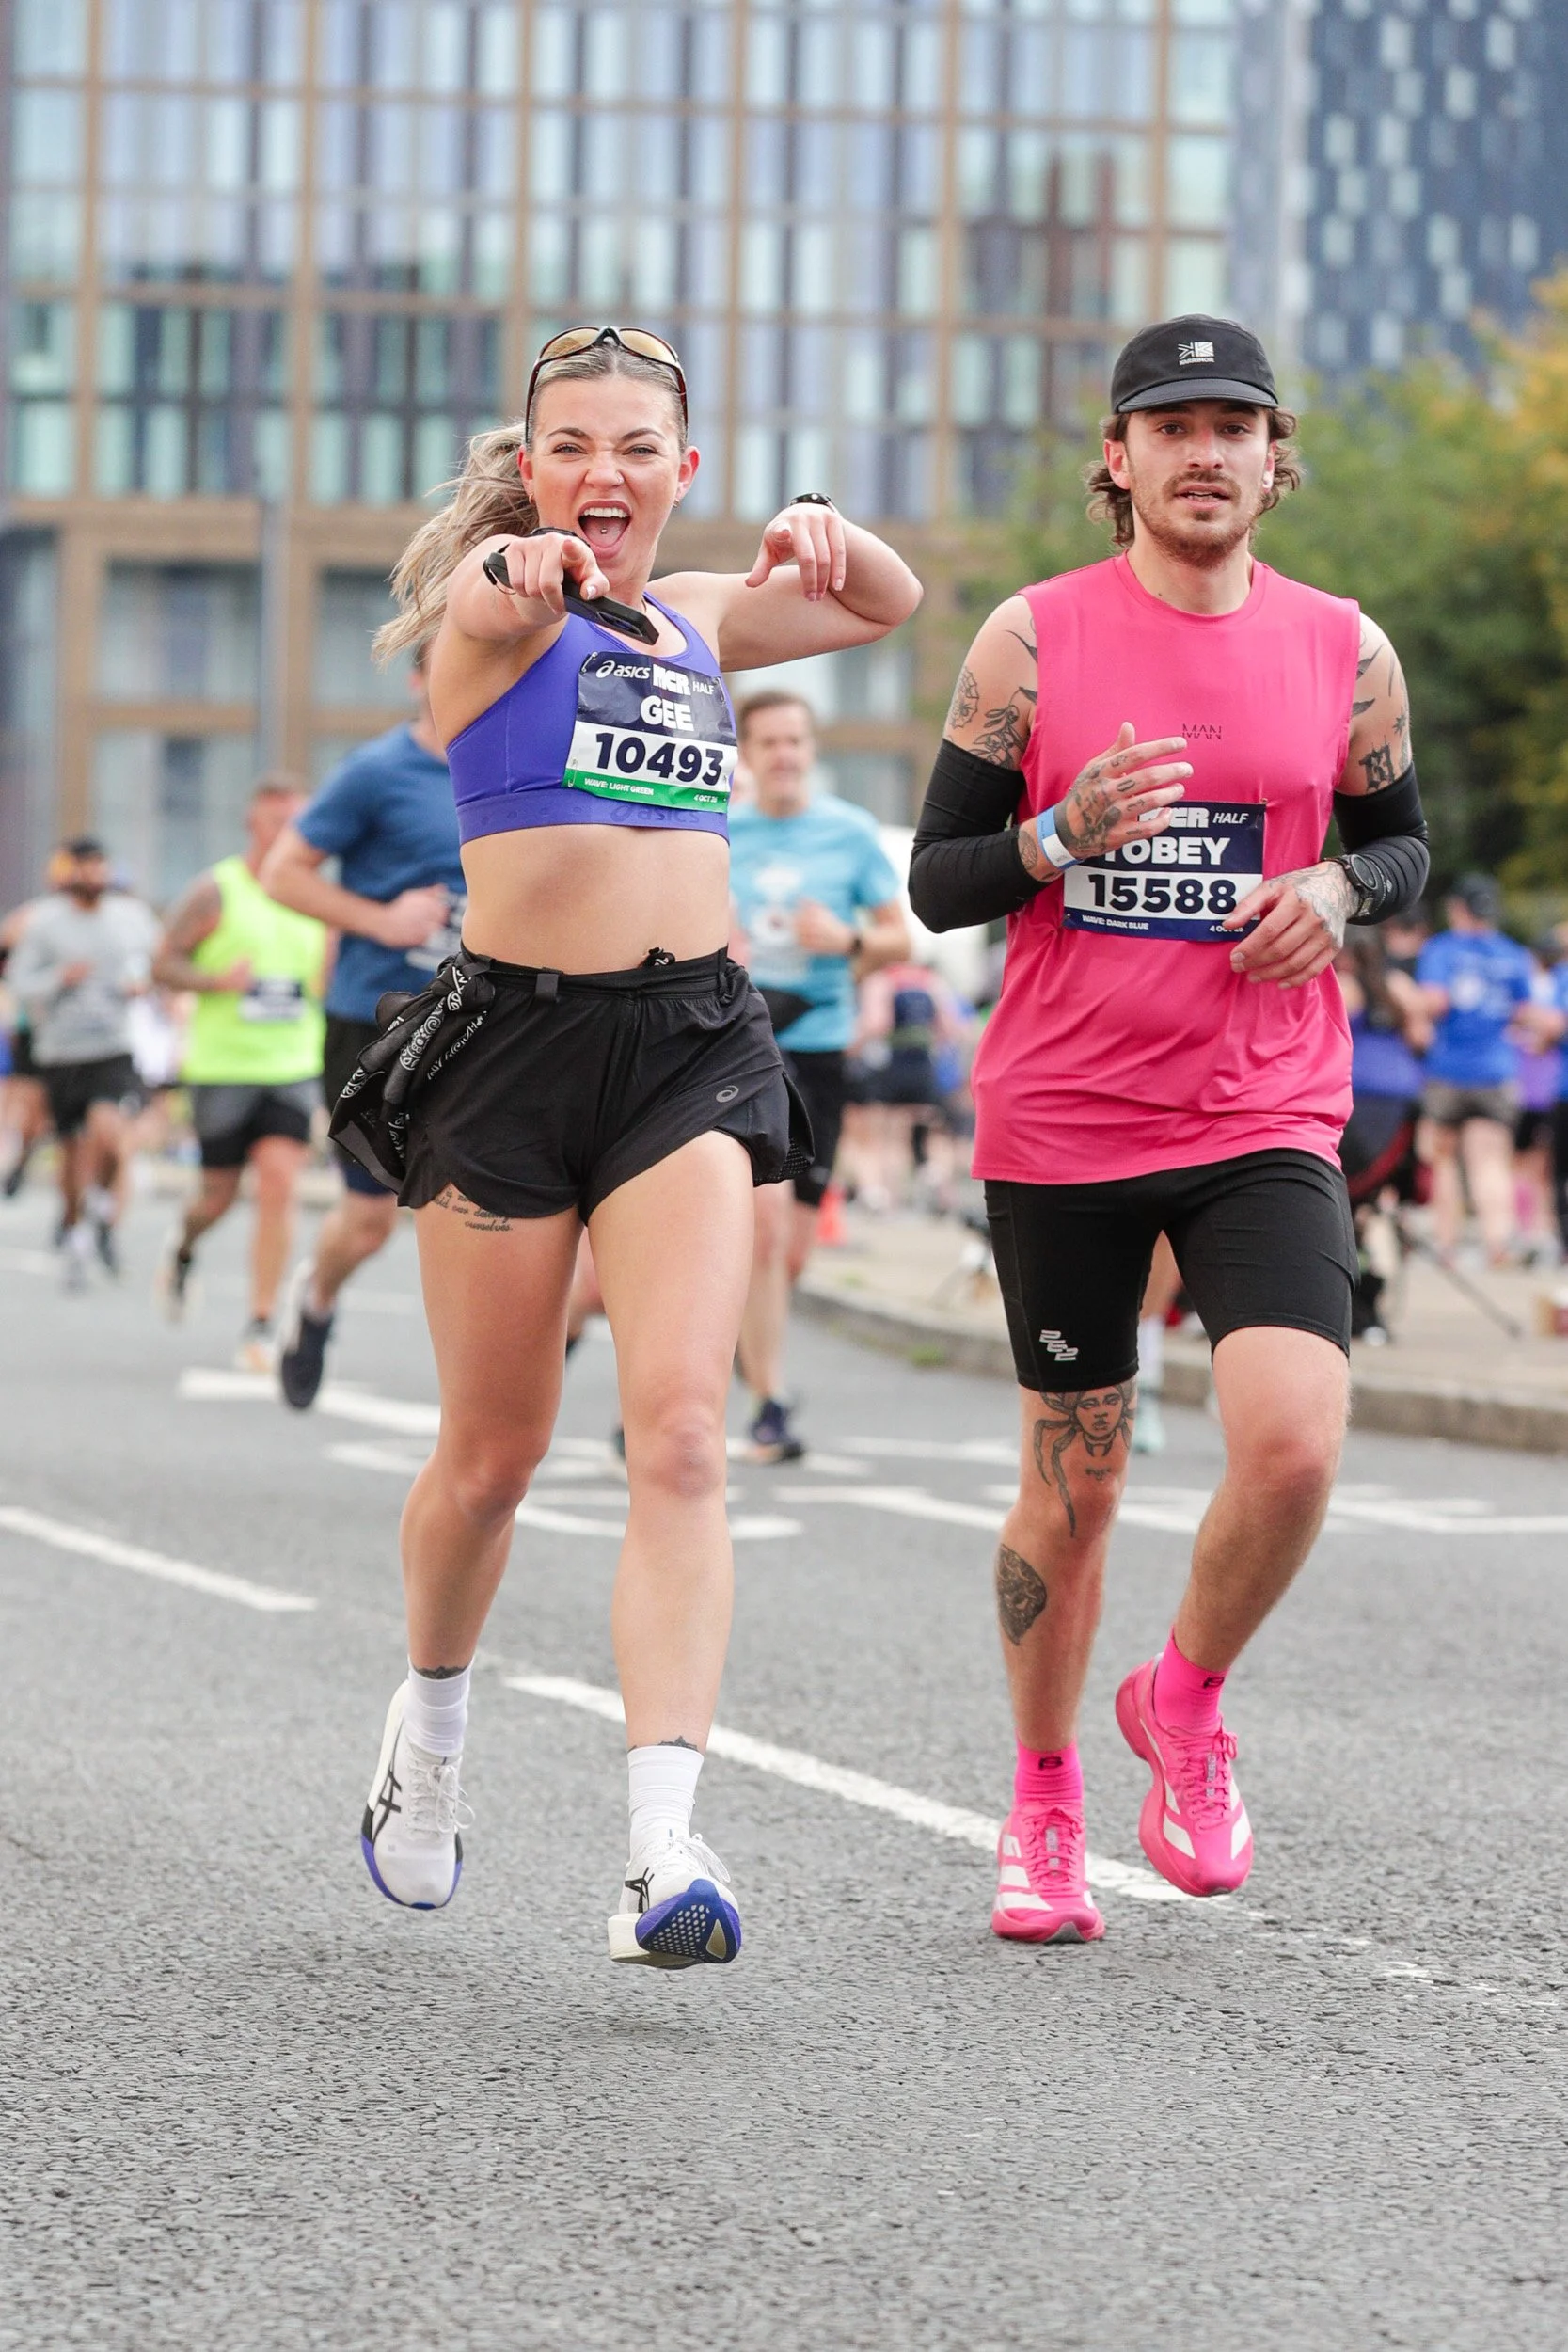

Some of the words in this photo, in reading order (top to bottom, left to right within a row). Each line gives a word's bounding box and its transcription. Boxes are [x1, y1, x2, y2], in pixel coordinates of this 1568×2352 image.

[693, 681, 715, 695] HALF
[640, 695, 694, 732] GEE
[595, 732, 724, 786] 10493
[609, 783, 630, 792] LIGHT
[630, 786, 654, 796] GREEN
[1212, 813, 1249, 824] HALF
[1088, 874, 1237, 914] 15588
[1106, 918, 1128, 929] DARK
[1128, 922, 1149, 930] BLUE
